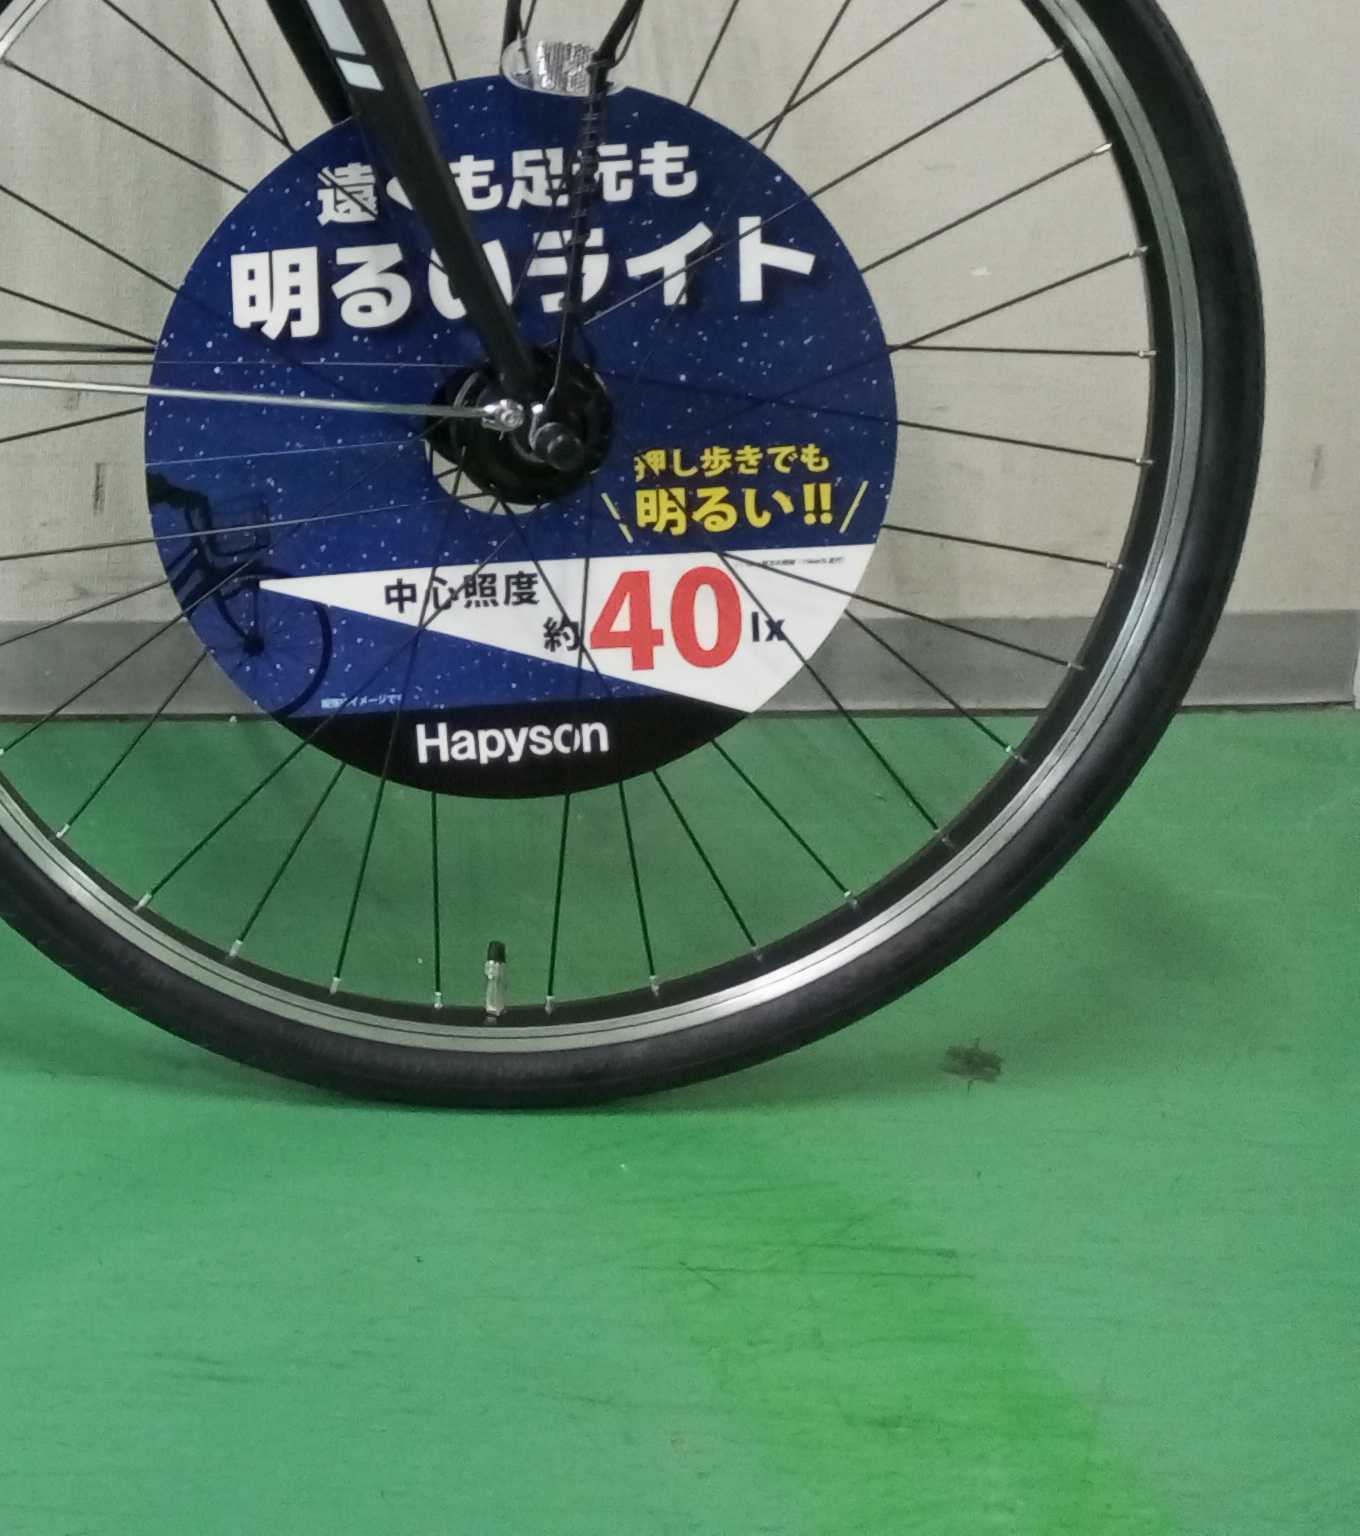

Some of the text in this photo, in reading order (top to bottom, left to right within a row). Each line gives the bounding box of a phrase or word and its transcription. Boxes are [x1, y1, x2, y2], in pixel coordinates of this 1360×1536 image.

[231, 216, 815, 339] 明るいライト
[634, 443, 829, 482] 押し歩きでも
[384, 571, 539, 614] 中心照度
[416, 722, 609, 764] Hapyson
